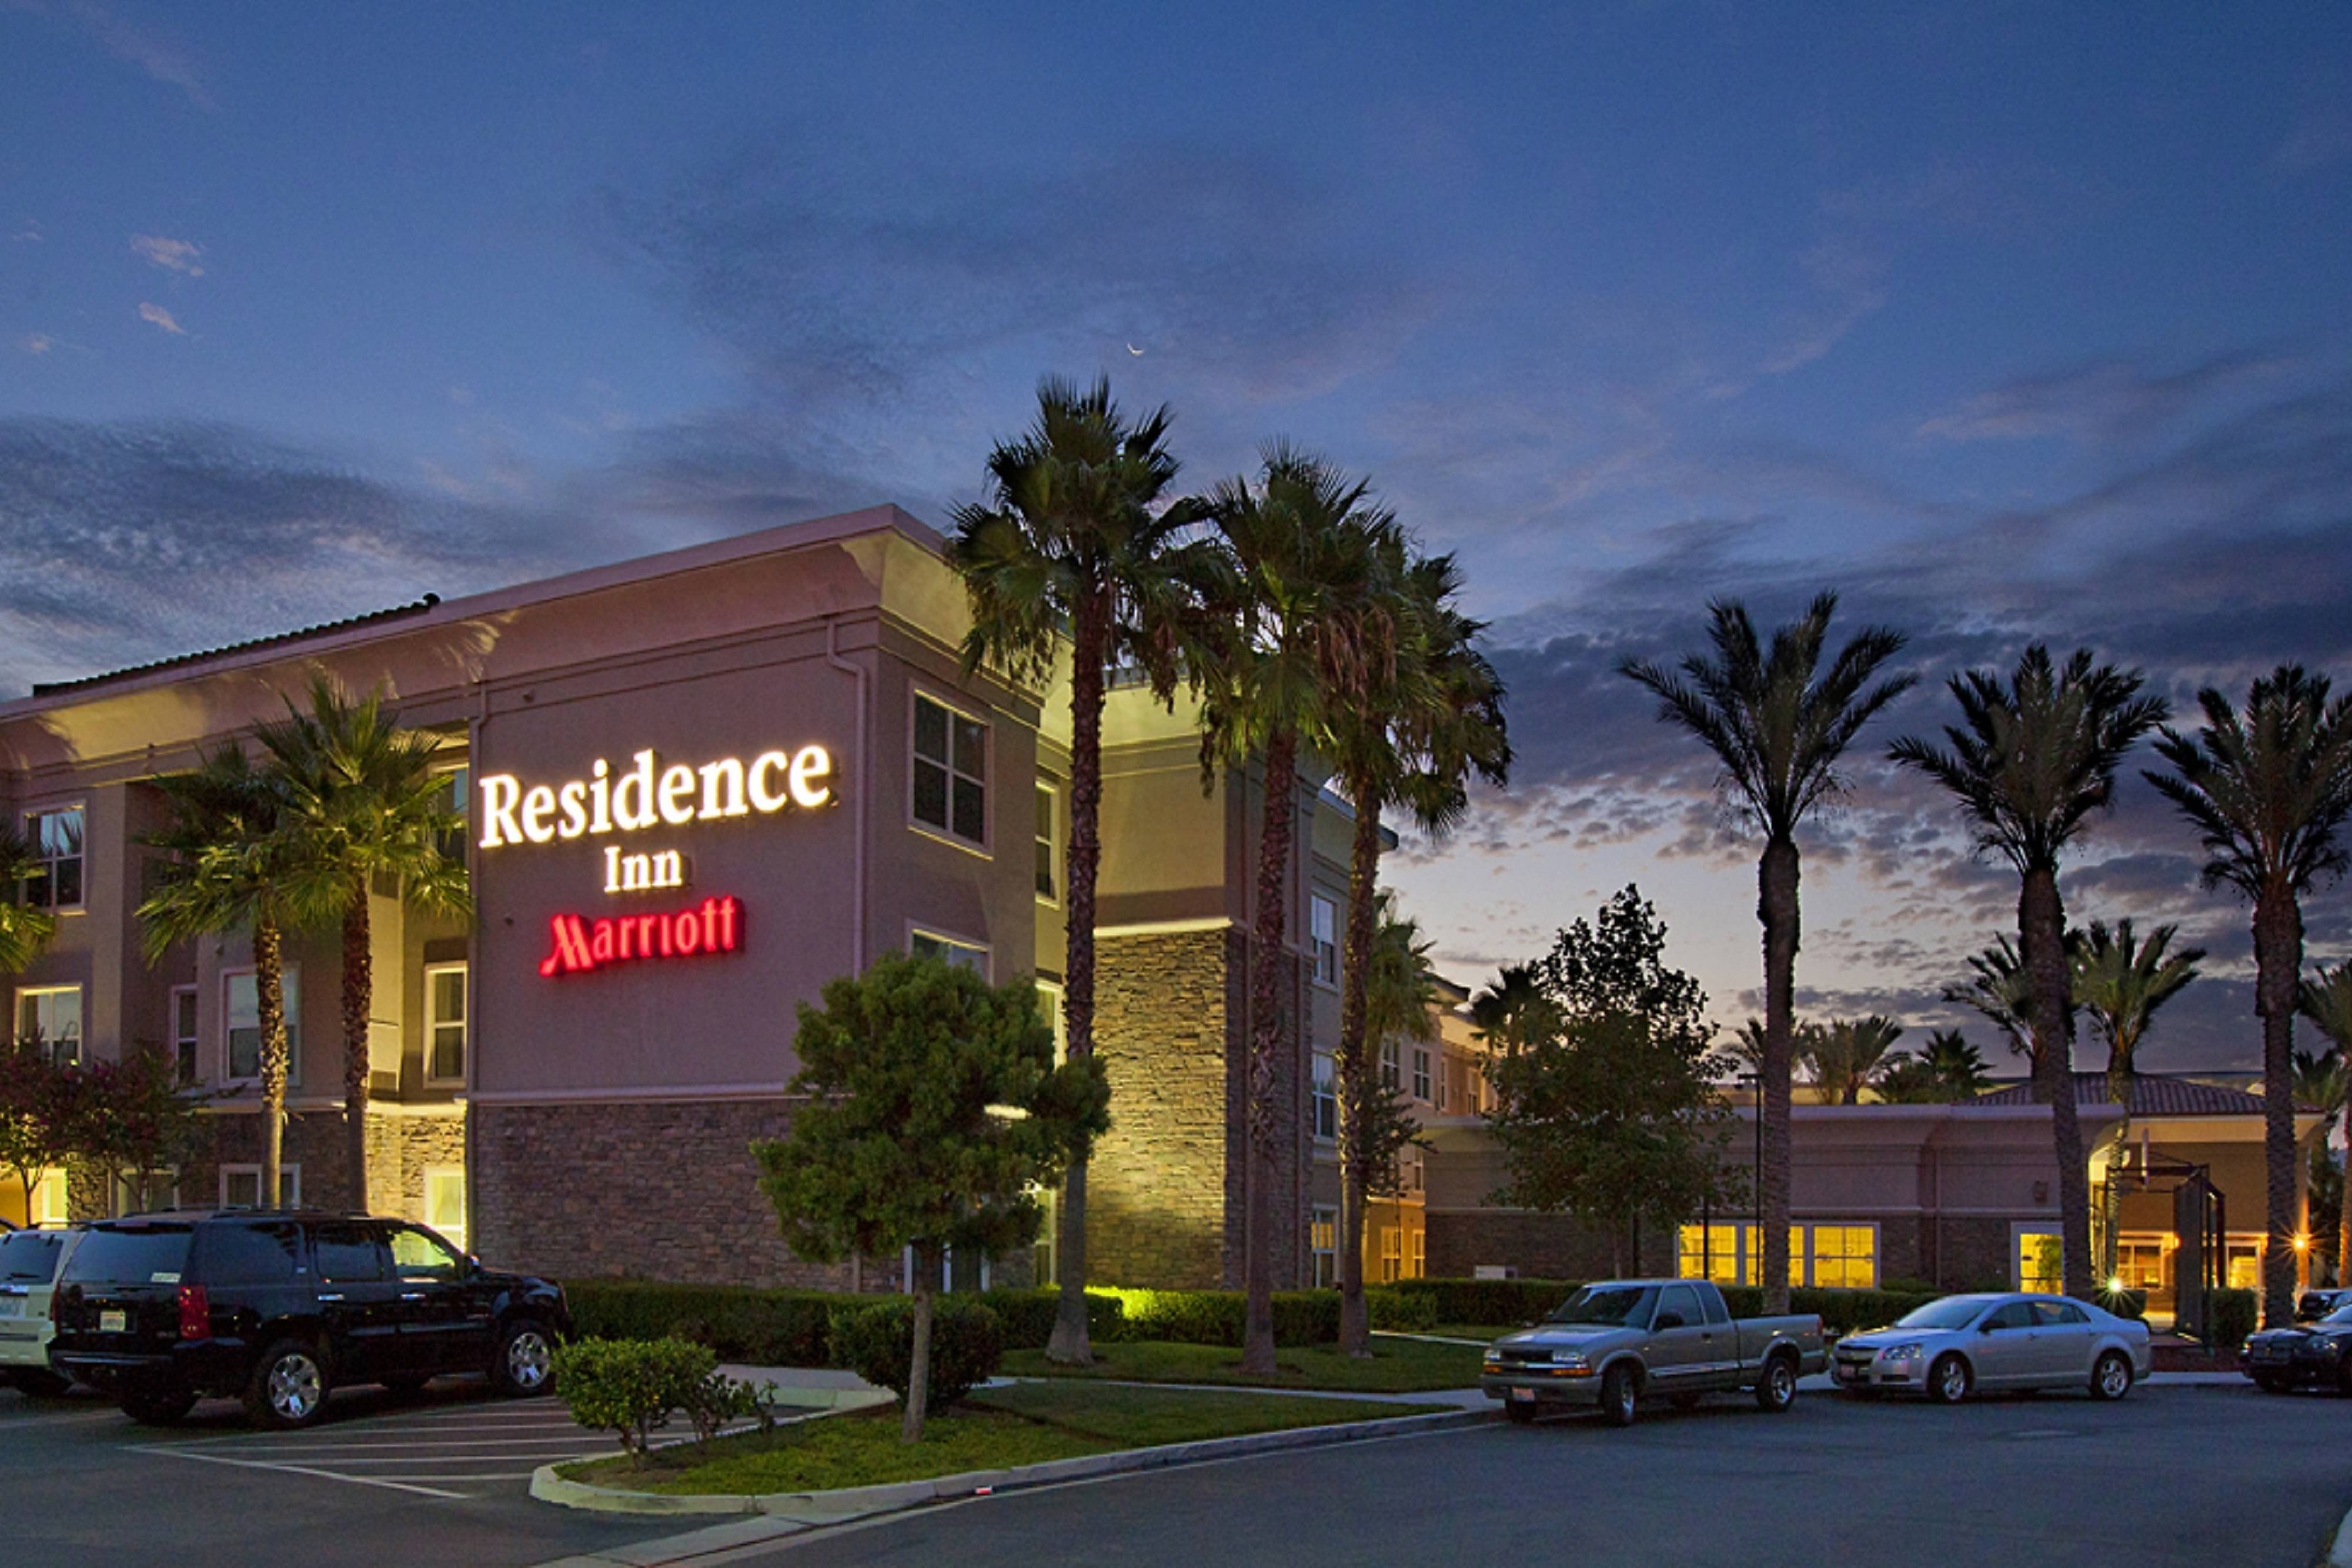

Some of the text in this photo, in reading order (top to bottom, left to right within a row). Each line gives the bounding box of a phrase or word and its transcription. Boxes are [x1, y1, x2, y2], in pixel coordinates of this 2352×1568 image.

[478, 744, 831, 848] Residence
[603, 845, 683, 893] Inn
[539, 895, 737, 977] Marriott
